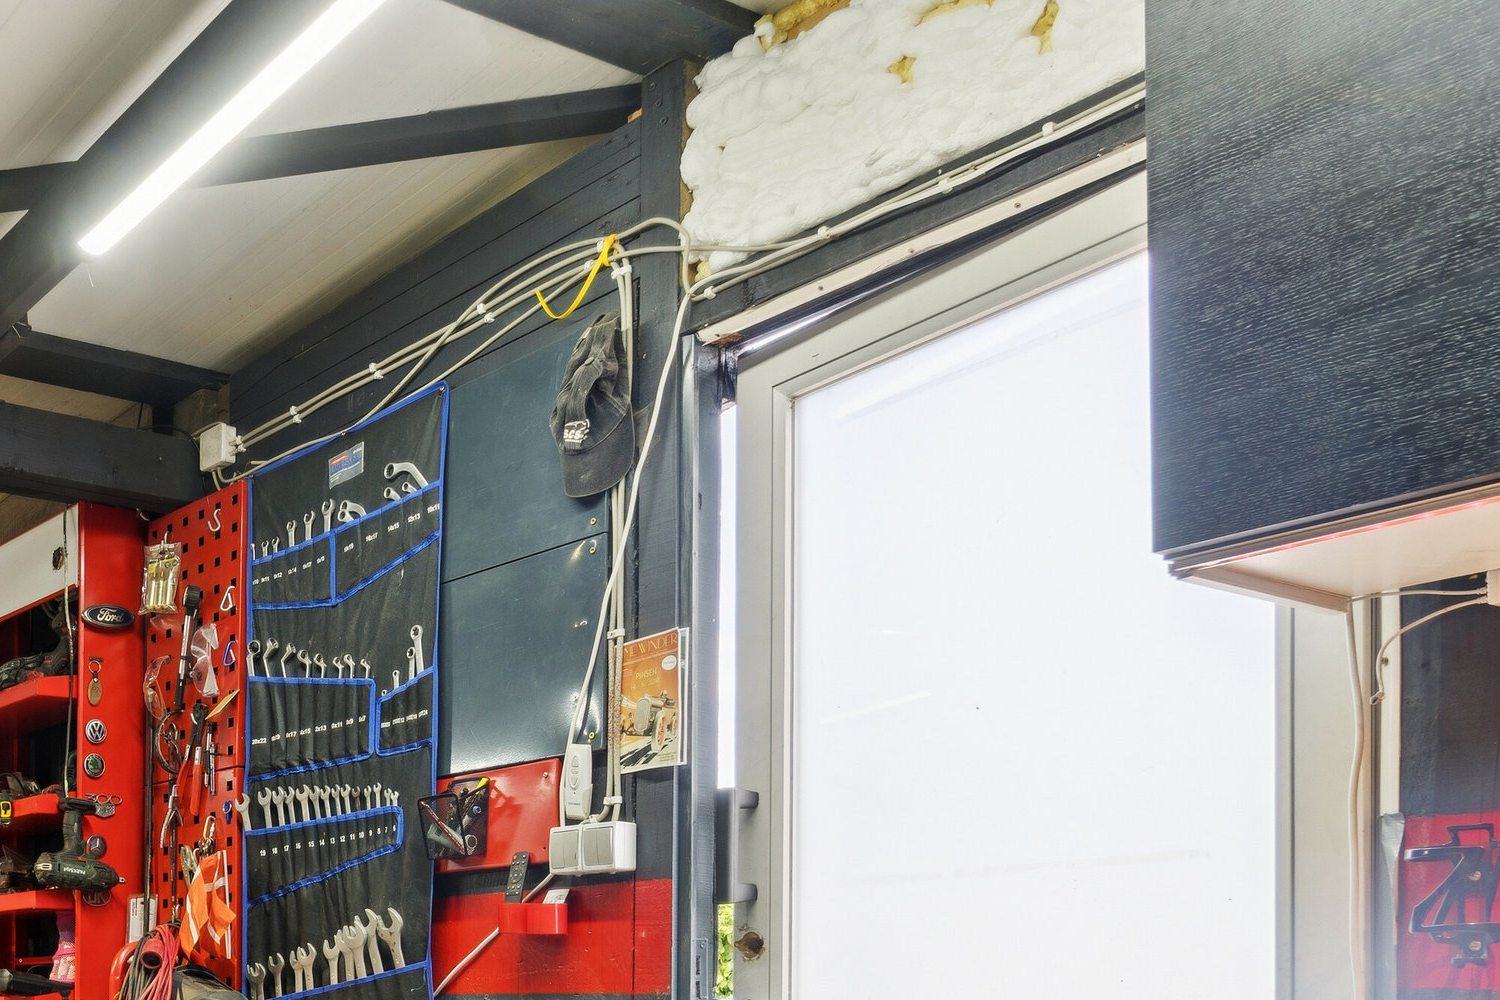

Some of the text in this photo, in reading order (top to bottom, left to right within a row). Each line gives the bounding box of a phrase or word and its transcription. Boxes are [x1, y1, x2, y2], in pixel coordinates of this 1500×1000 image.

[97, 608, 124, 622] Ford
[639, 631, 679, 654] WINDER
[85, 793, 122, 804] 300
